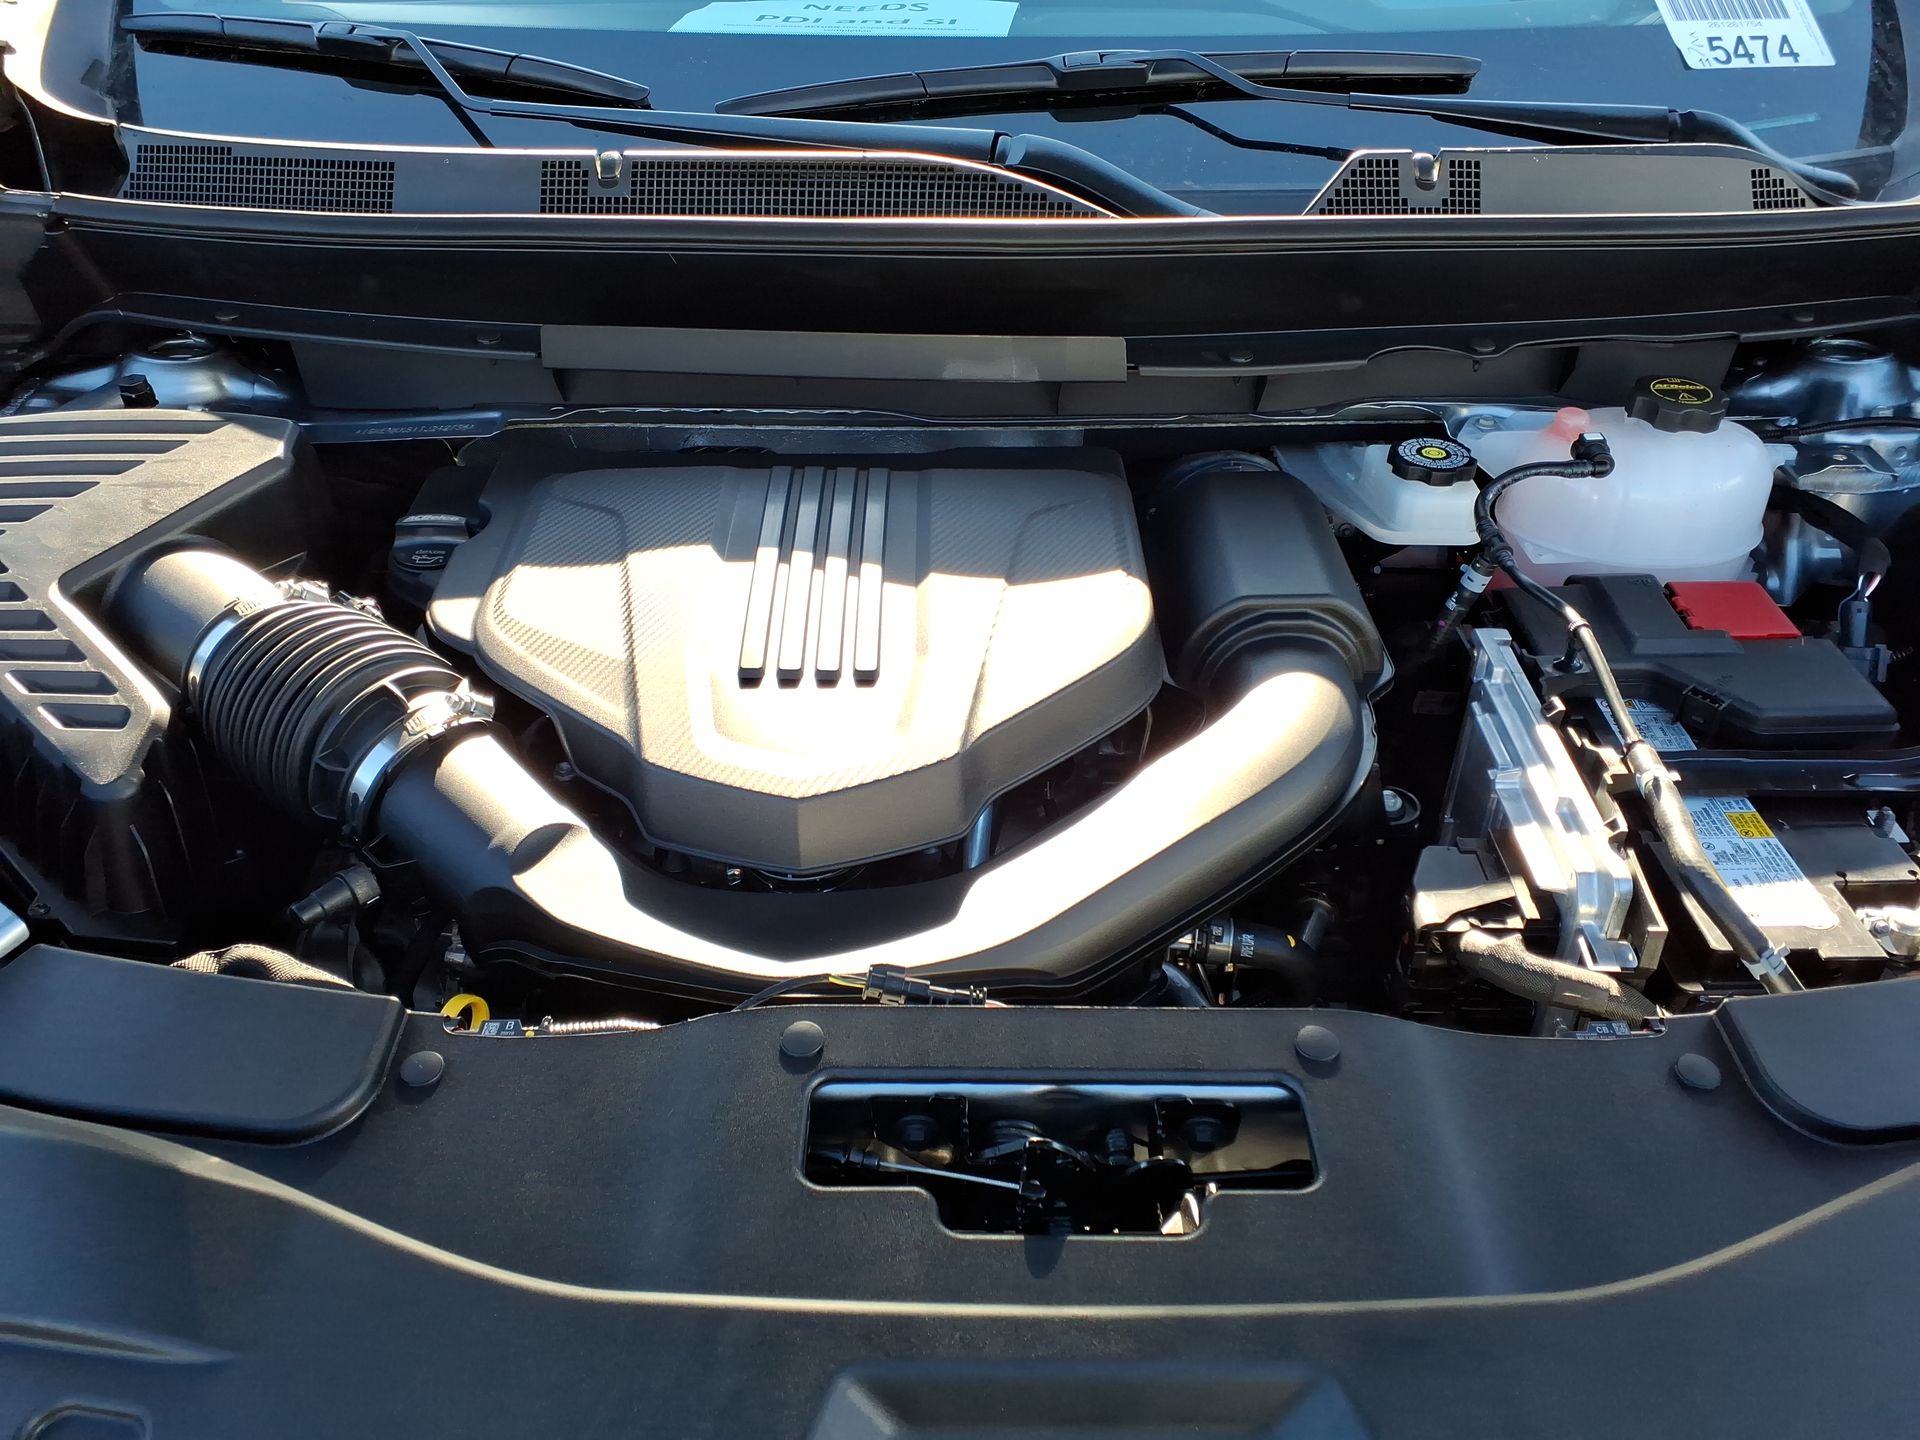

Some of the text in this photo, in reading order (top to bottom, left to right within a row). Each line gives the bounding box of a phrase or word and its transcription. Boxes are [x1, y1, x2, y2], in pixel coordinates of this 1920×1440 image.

[803, 2, 929, 12] NEEDS
[754, 14, 823, 25] PDI
[1706, 34, 1800, 65] 5474
[505, 1021, 515, 1030] B
